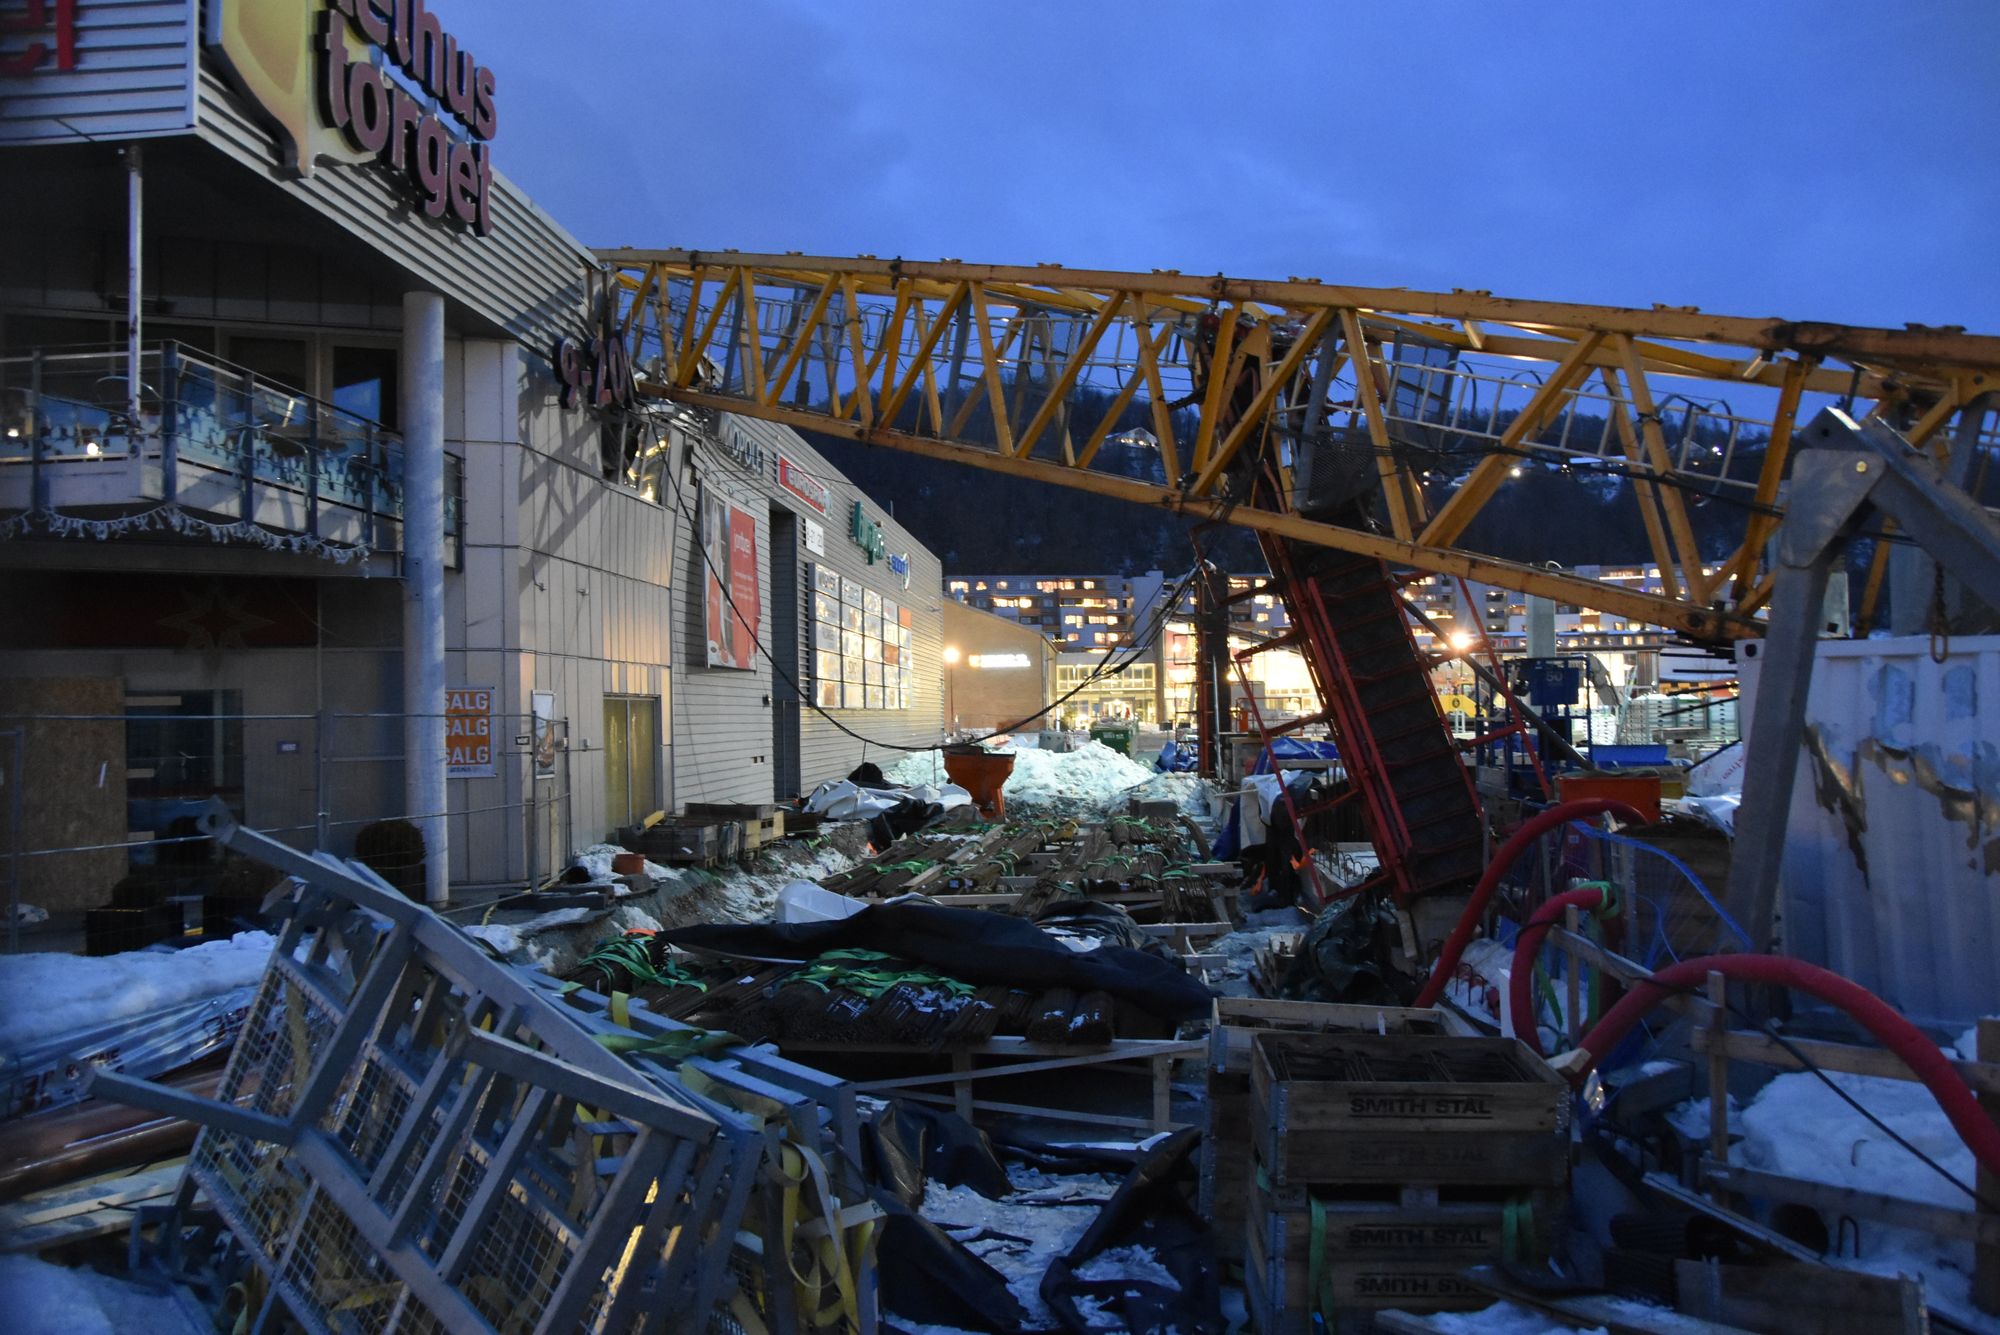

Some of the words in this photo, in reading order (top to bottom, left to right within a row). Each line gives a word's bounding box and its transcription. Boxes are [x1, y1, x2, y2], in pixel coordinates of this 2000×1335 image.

[327, 0, 497, 141] elhus
[316, 9, 496, 237] torget
[1350, 1098, 1426, 1114] SMITH
[1348, 1229, 1424, 1244] SMITH
